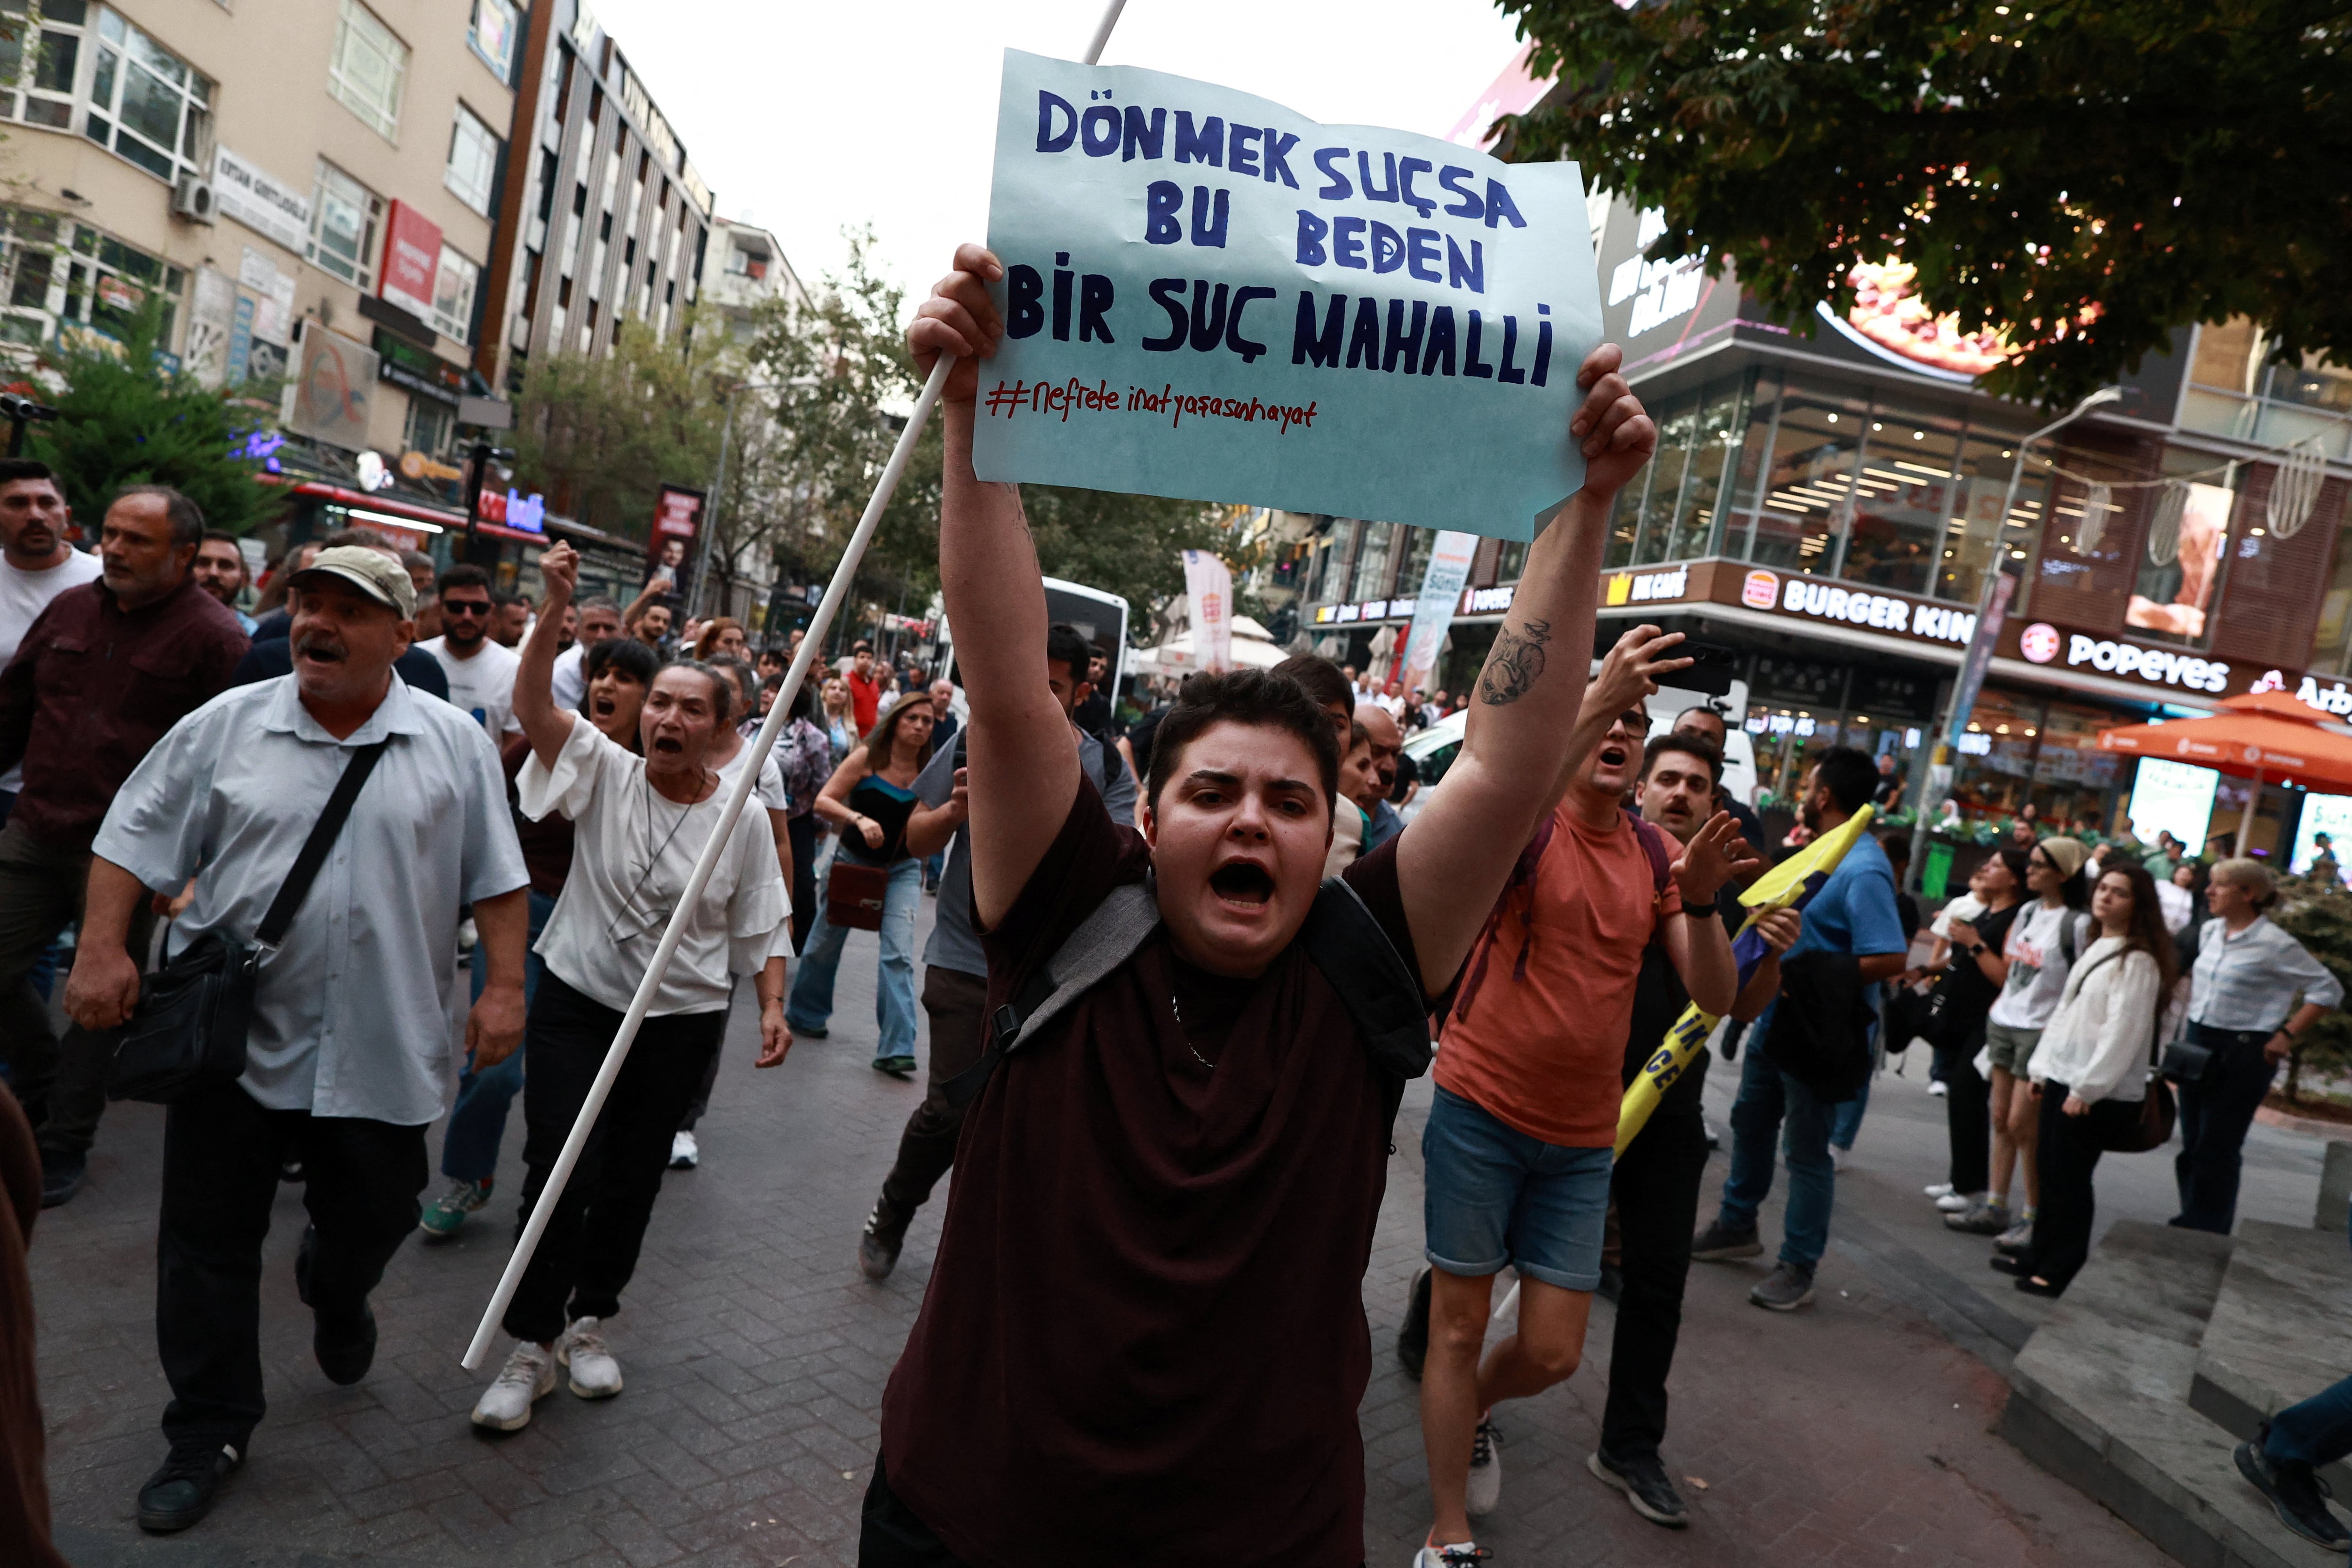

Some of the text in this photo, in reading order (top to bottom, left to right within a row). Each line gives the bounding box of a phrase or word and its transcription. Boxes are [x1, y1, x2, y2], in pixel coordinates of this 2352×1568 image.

[1035, 88, 1301, 190] DÖNMEK
[1313, 148, 1527, 229] SUÇSA
[1144, 180, 1485, 294] BU BEDEN
[1005, 252, 1553, 388] BİR SUÇ MAHALLİ
[1783, 579, 1978, 645] BURGER KIN
[2295, 676, 2352, 724] Arb
